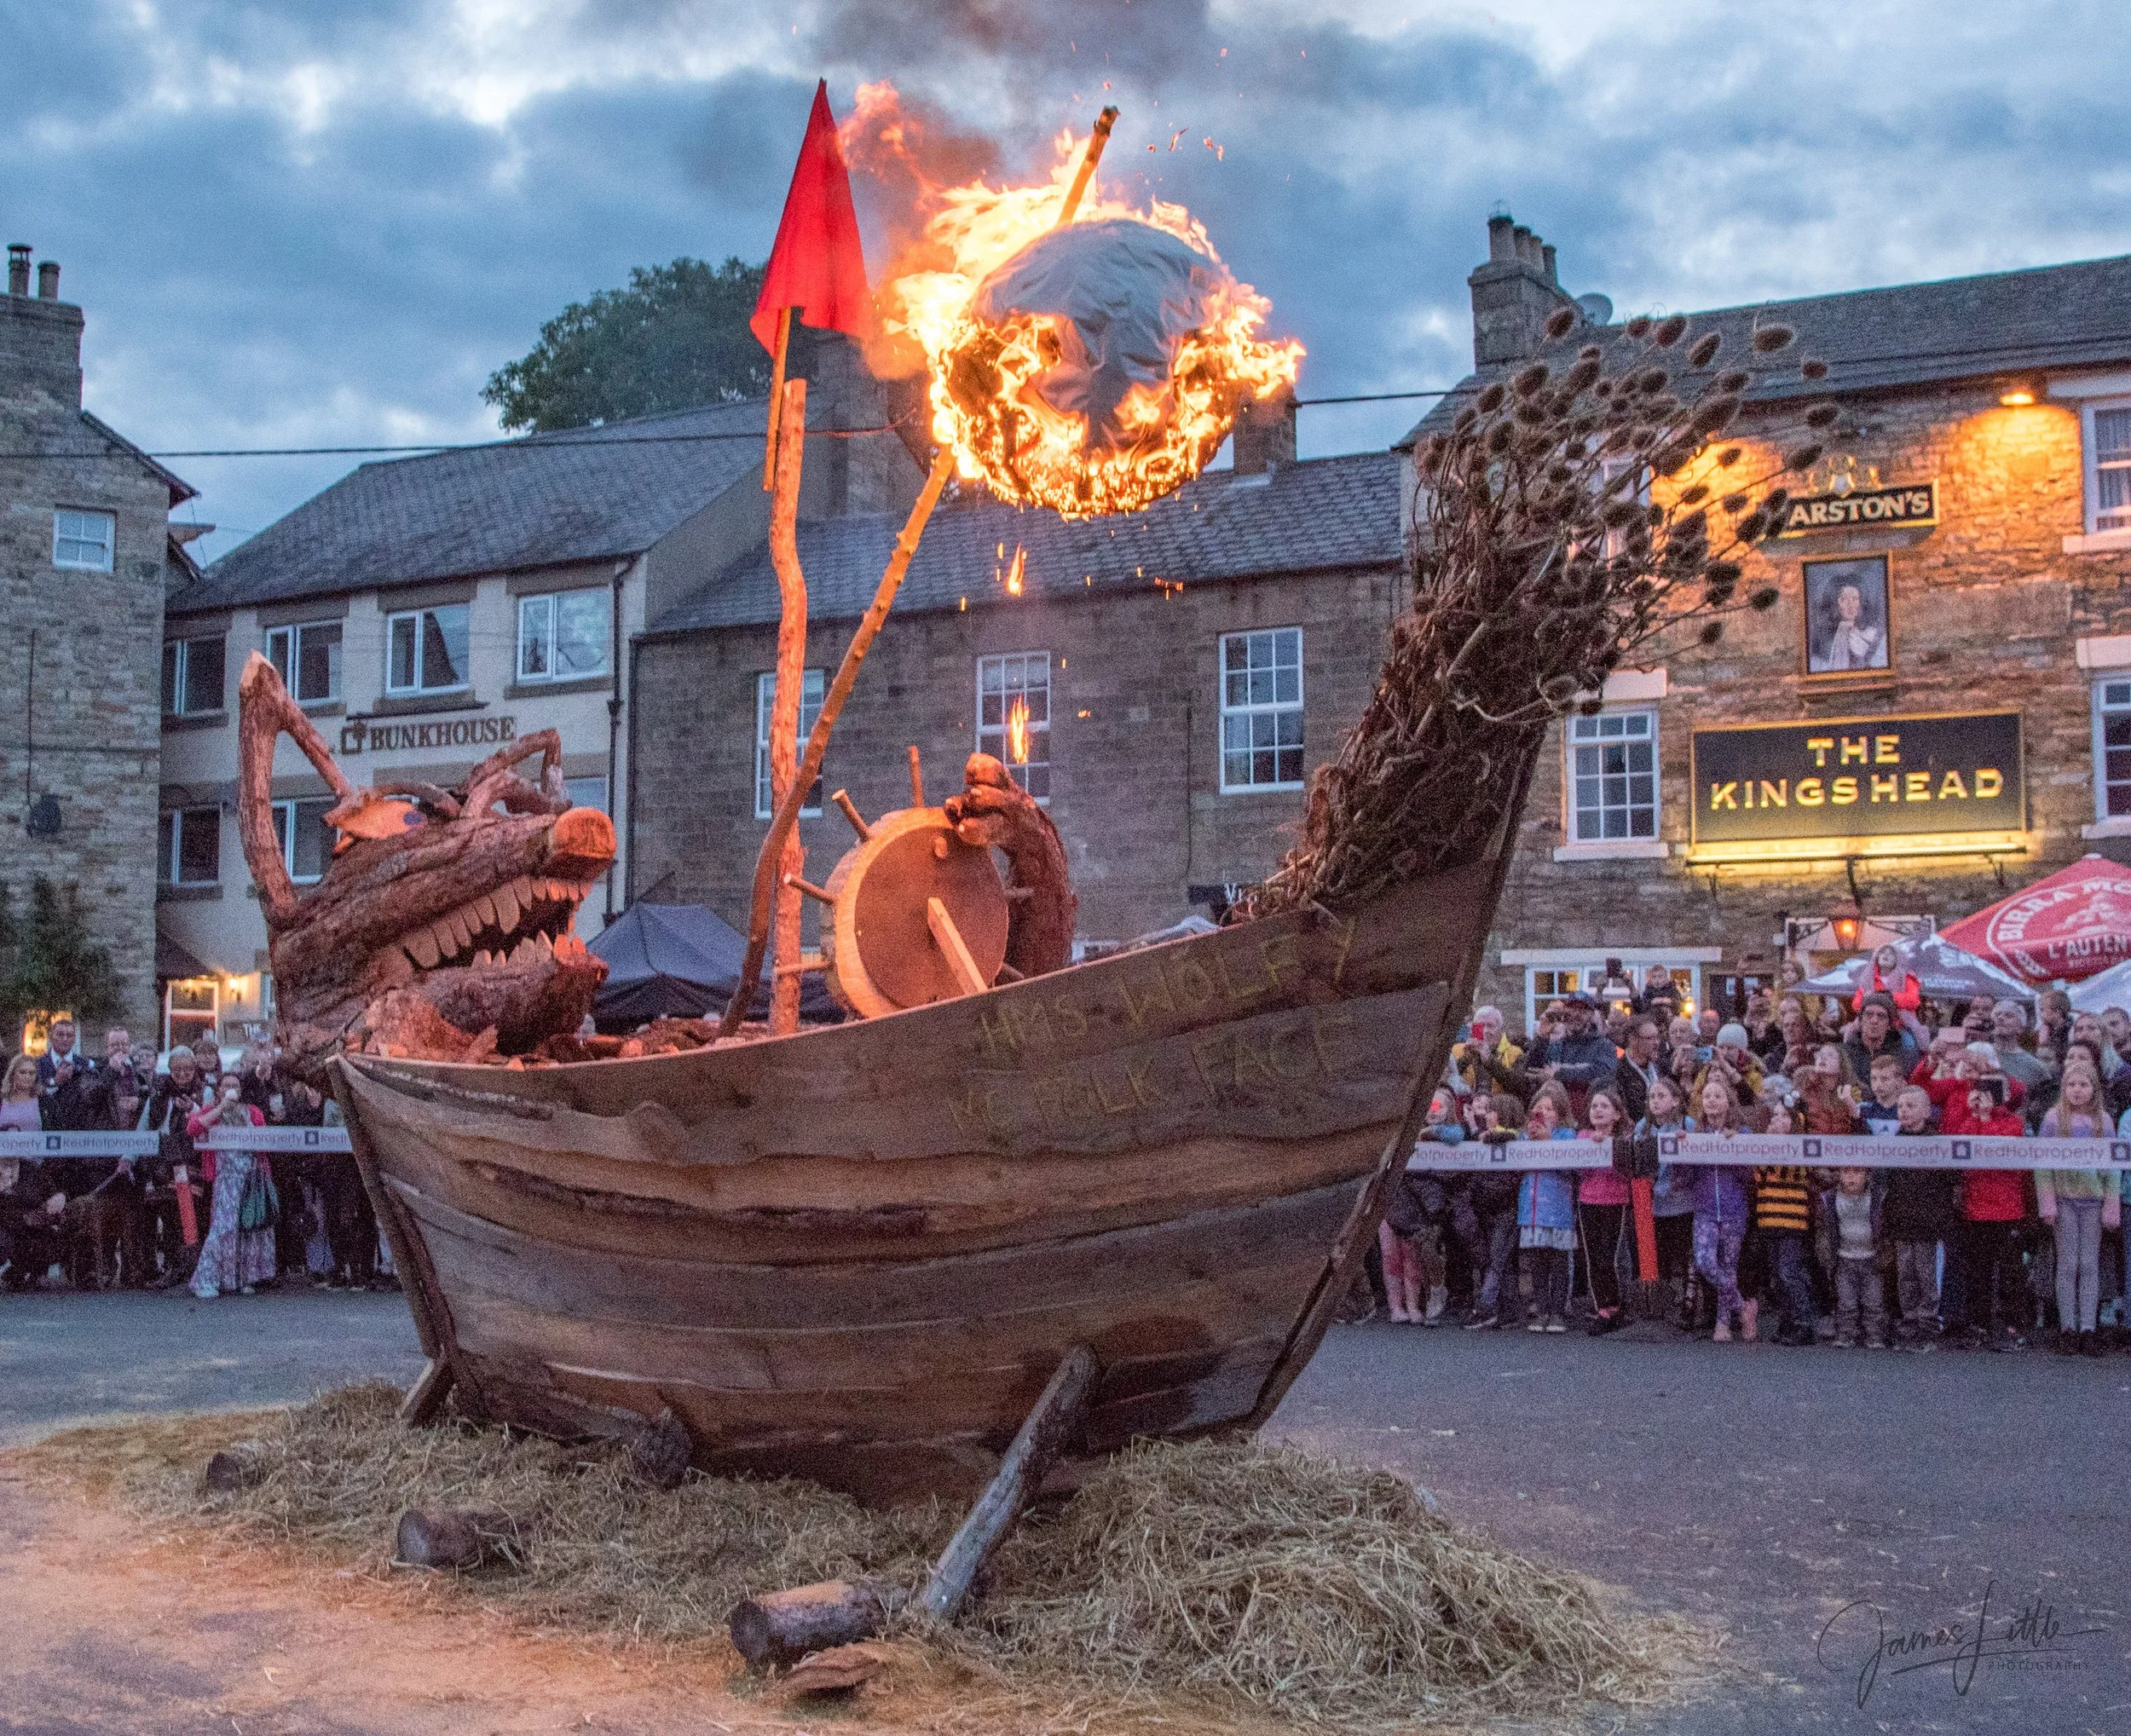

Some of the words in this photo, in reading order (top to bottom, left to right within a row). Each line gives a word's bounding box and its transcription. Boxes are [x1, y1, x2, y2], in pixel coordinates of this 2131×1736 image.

[1787, 490, 1930, 527] ARSTON'S
[370, 716, 517, 750] BUNKHOUSE
[1806, 735, 1901, 767] THE
[1710, 776, 1859, 810] KINGS
[1870, 768, 2004, 803] HEAD
[1997, 891, 2077, 941] BIRRA
[979, 992, 1089, 1059] HMS
[1508, 1145, 1609, 1160] RedHotproperty
[1680, 1138, 1799, 1156] RedHotproperty
[1824, 1140, 1949, 1159] RedHotproperty
[1974, 1141, 2105, 1161] RedHotproperty
